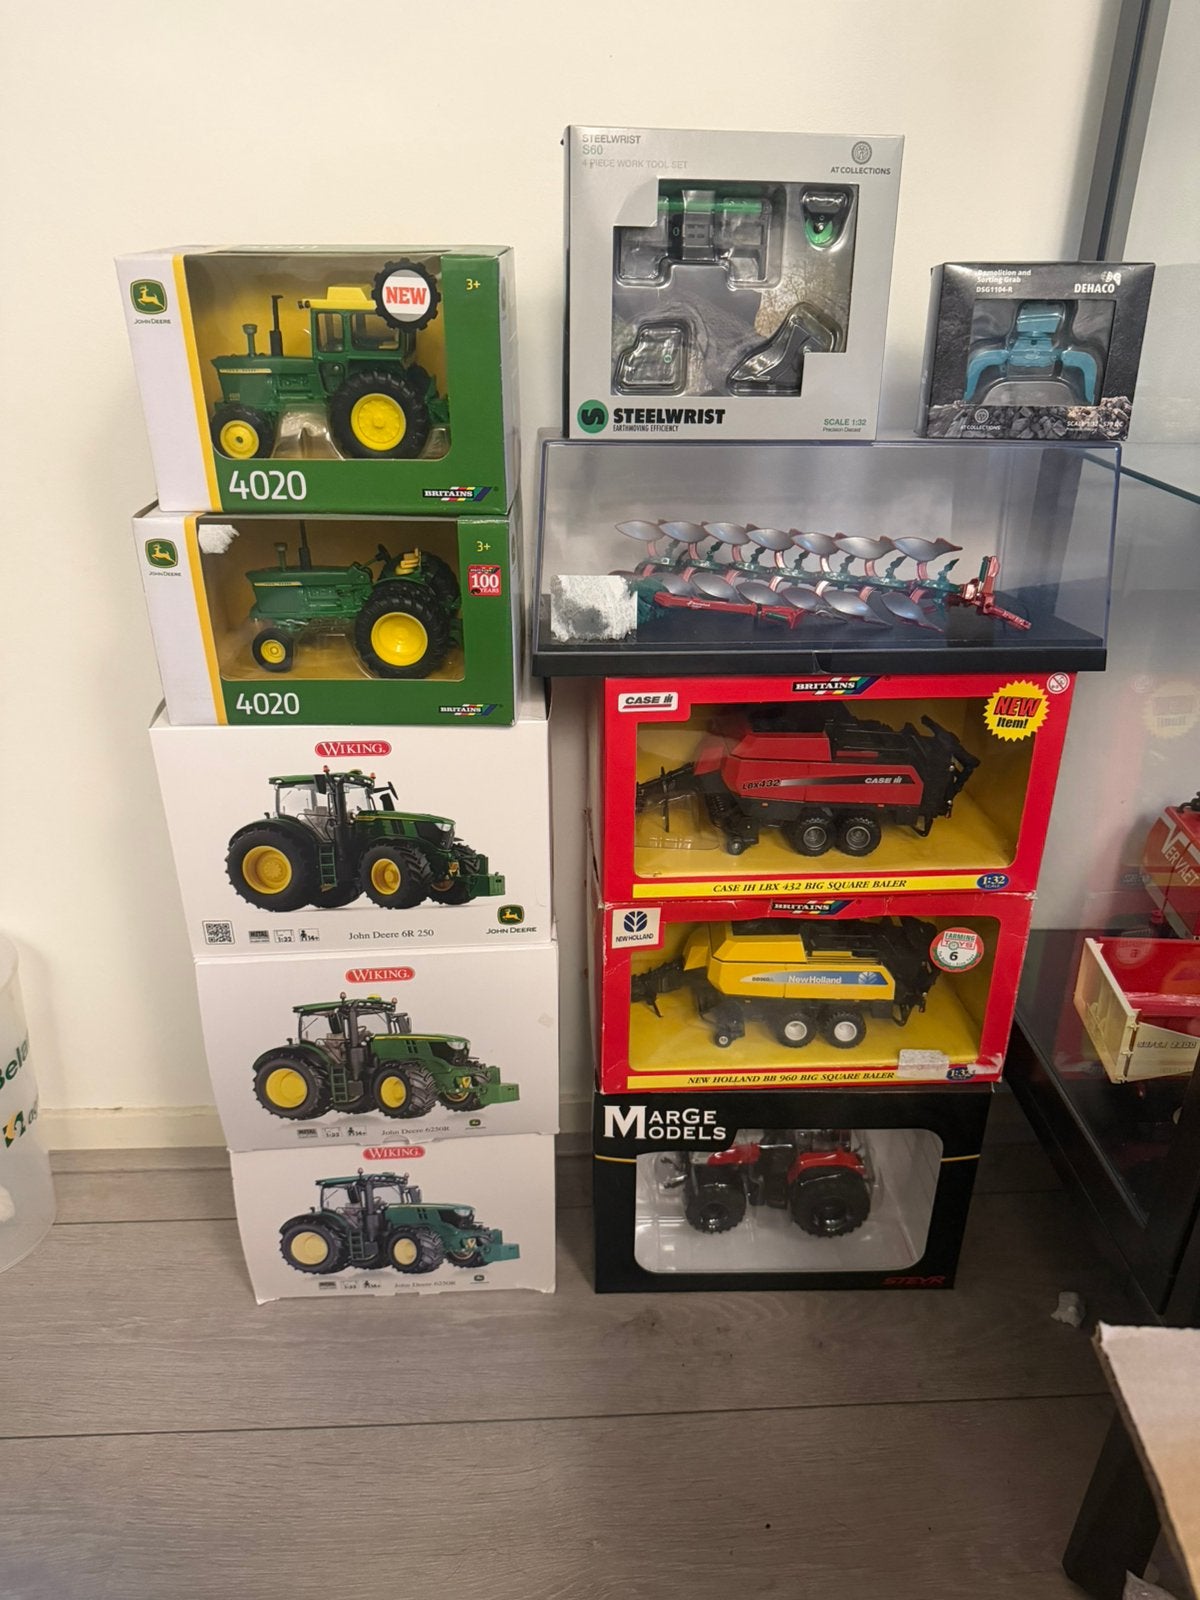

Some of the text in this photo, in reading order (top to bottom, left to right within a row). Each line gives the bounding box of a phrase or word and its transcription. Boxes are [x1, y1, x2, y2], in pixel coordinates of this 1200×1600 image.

[582, 134, 641, 144] STEELWRIST
[582, 144, 603, 155] S60
[617, 160, 644, 168] WORK
[646, 160, 669, 169] TOOL
[671, 160, 688, 169] SET
[840, 166, 891, 175] COLLECTIONS
[466, 278, 481, 291] 3+
[977, 276, 1003, 284] Sorting
[1074, 283, 1115, 293] DEHACO
[385, 286, 427, 305] NEW
[613, 408, 726, 424] STEELWRIST
[823, 418, 867, 426] SCALE 1:32
[613, 424, 679, 432] EARTHMOVING EFFICIENCY
[229, 470, 307, 500] 4020
[476, 541, 491, 552] 3+
[471, 574, 499, 588] 100
[795, 682, 856, 690] BRITAINS
[236, 692, 300, 715] 4020
[625, 696, 661, 704] CASE
[993, 696, 1042, 717] NEW
[321, 742, 383, 756] WIKING
[983, 875, 1005, 885] 1:32
[713, 880, 907, 892] CASE IH LBX 432 BIG SQUARE BALER
[774, 903, 830, 911] BRITAINS
[349, 929, 434, 940] John Deere 6R 250
[627, 933, 654, 941] HOLLAND
[945, 932, 976, 942] FARMING
[950, 951, 959, 961] 6
[352, 968, 408, 981] WIKING
[688, 1076, 709, 1084] NEW
[712, 1075, 760, 1083] HOLLAND
[779, 1074, 797, 1082] 960
[800, 1073, 818, 1081] BIG
[821, 1072, 860, 1081] SQUARE
[369, 1147, 418, 1159] WIKING
[882, 1275, 946, 1285] STEYR
